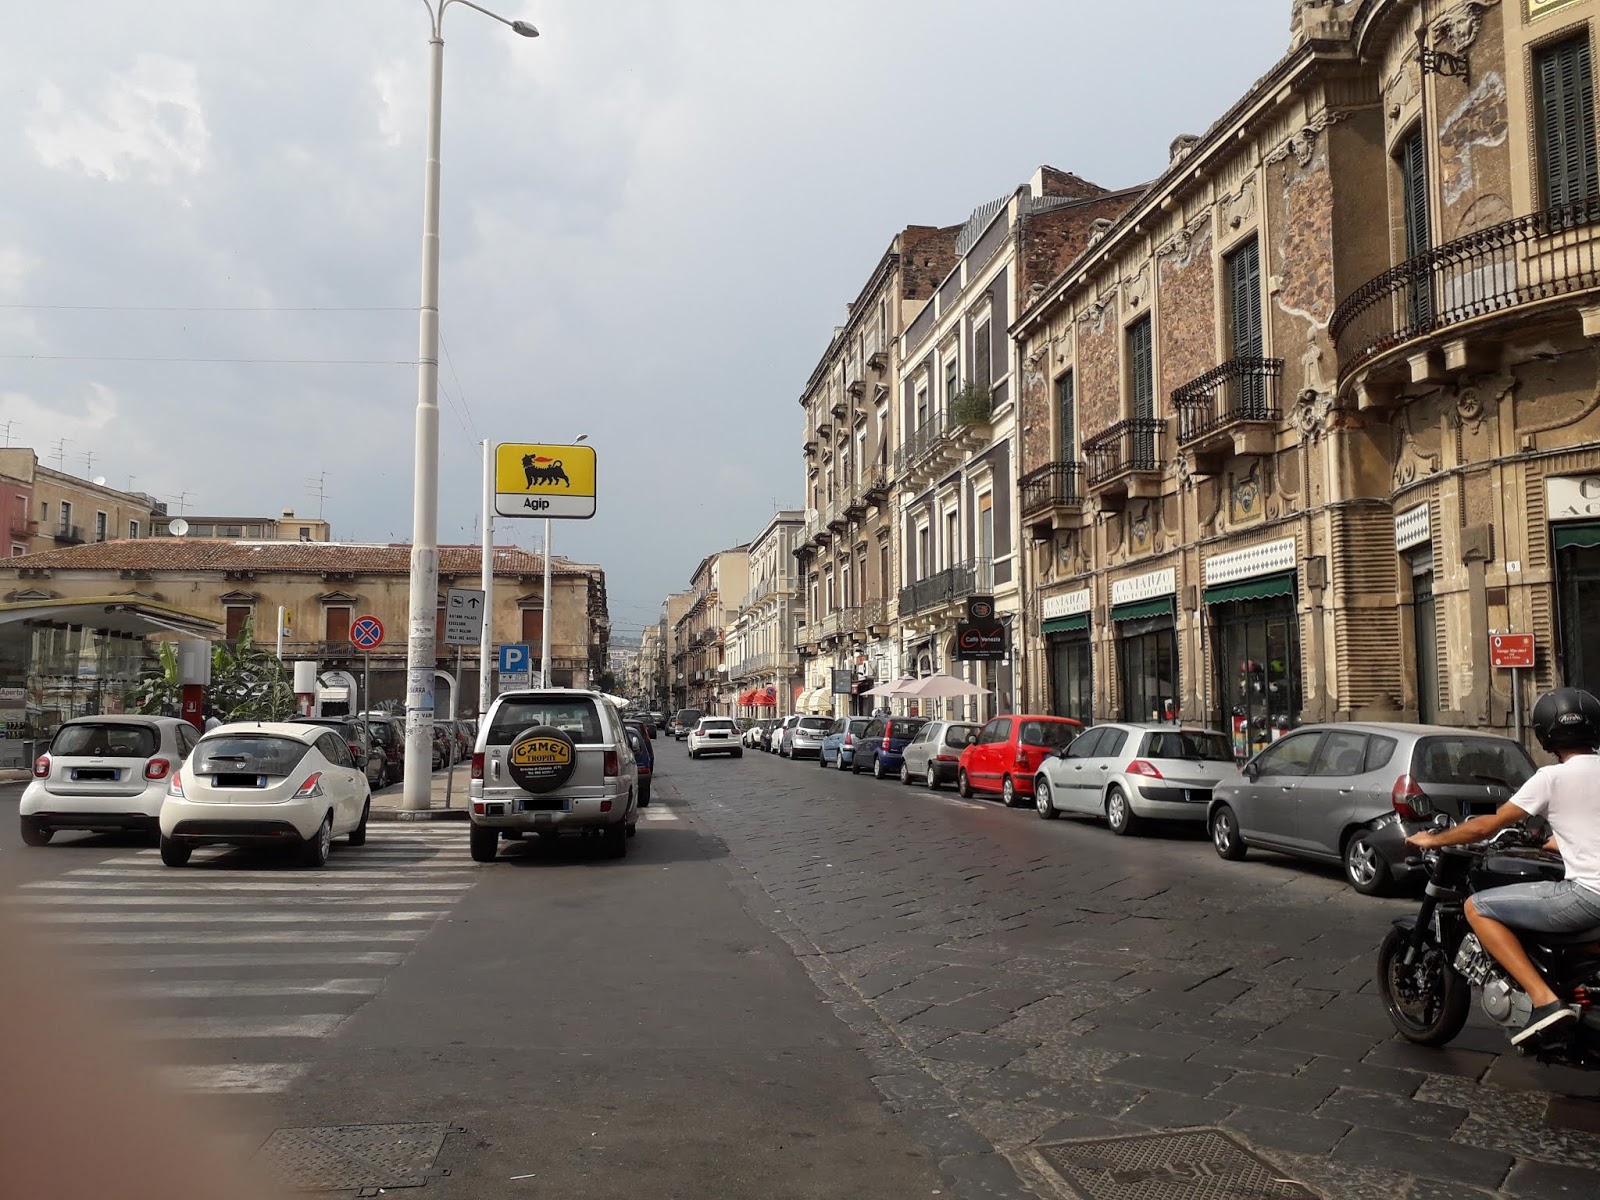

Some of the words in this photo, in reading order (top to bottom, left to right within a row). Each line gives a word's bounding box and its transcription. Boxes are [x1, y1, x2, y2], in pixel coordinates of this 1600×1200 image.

[523, 497, 550, 511] Agip
[1511, 563, 1516, 571] 9
[505, 648, 523, 670] P
[517, 742, 567, 757] CAMEL
[527, 754, 556, 762] TROPHY
